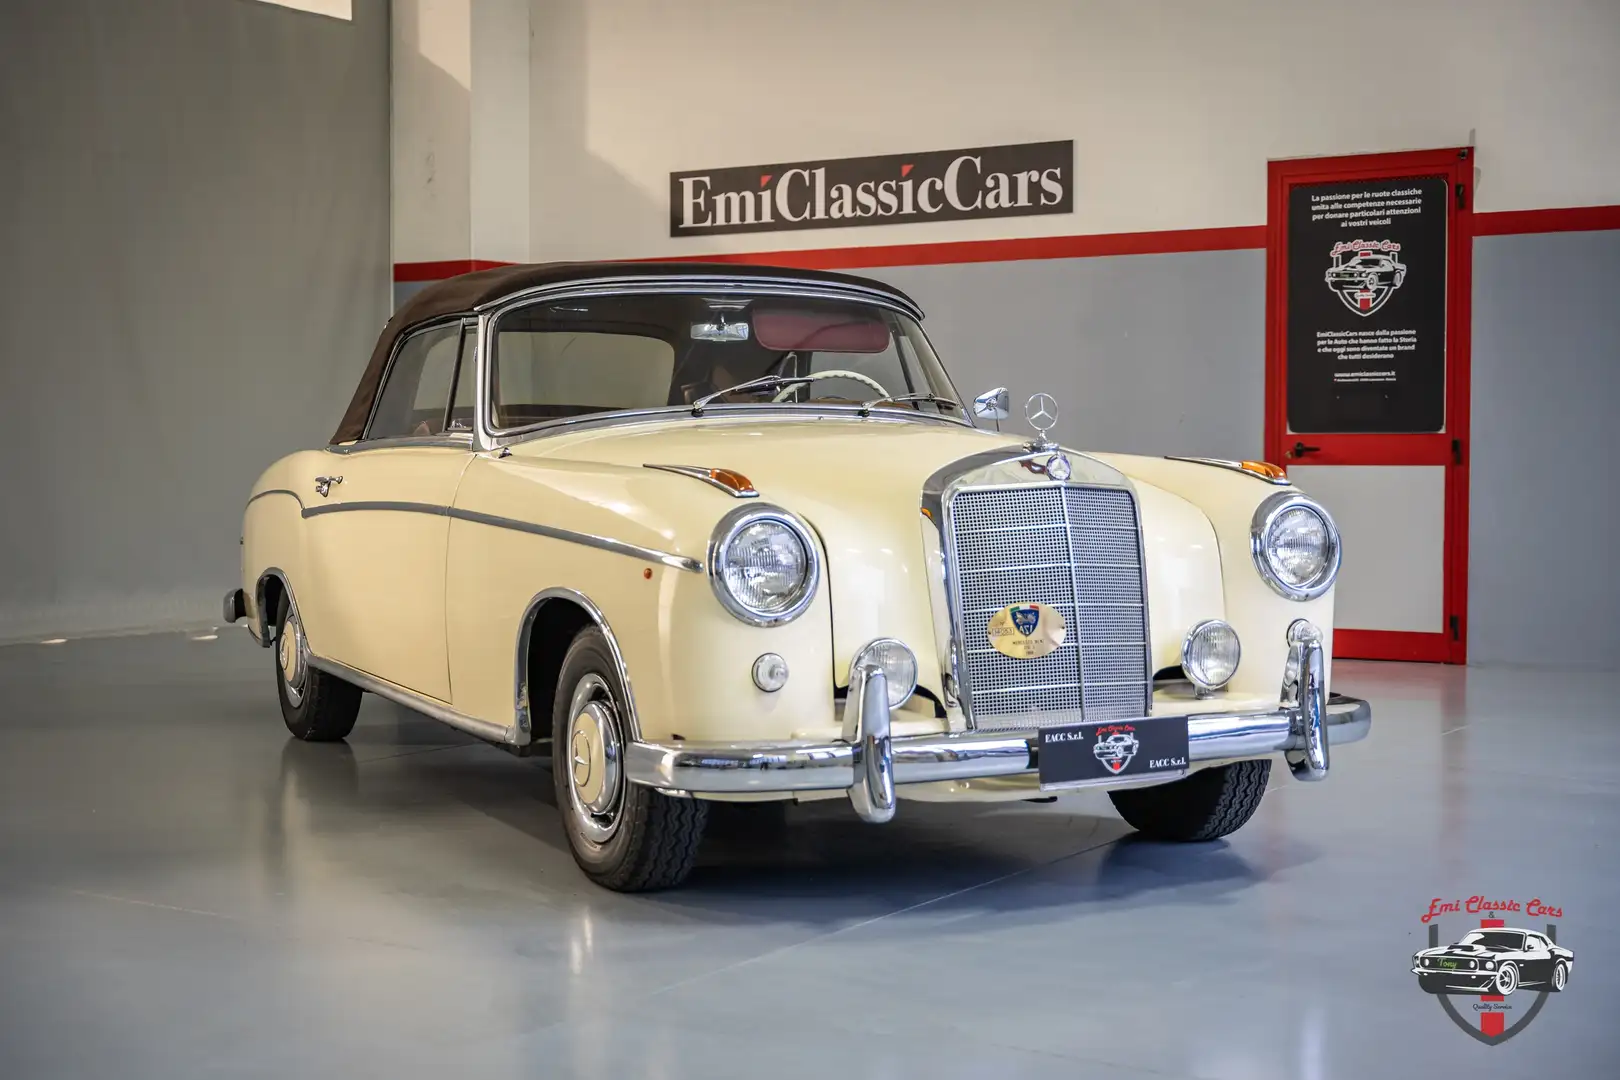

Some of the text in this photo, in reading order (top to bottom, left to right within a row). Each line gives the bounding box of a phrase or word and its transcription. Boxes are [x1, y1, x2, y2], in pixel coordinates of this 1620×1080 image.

[679, 155, 1064, 228] EmiClassicCars
[1320, 194, 1350, 202] passione
[1391, 188, 1422, 196] classiche
[1343, 201, 1385, 209] competenze
[1386, 198, 1422, 206] necessarie
[1325, 211, 1349, 219] donare
[1350, 208, 1385, 218] particolari
[1386, 207, 1421, 215] attenzioni
[1348, 219, 1368, 227] vostri
[1369, 218, 1391, 226] veicoli
[1045, 731, 1084, 743] EACC S.r.l.
[1150, 757, 1186, 768] EACC S.r.l.
